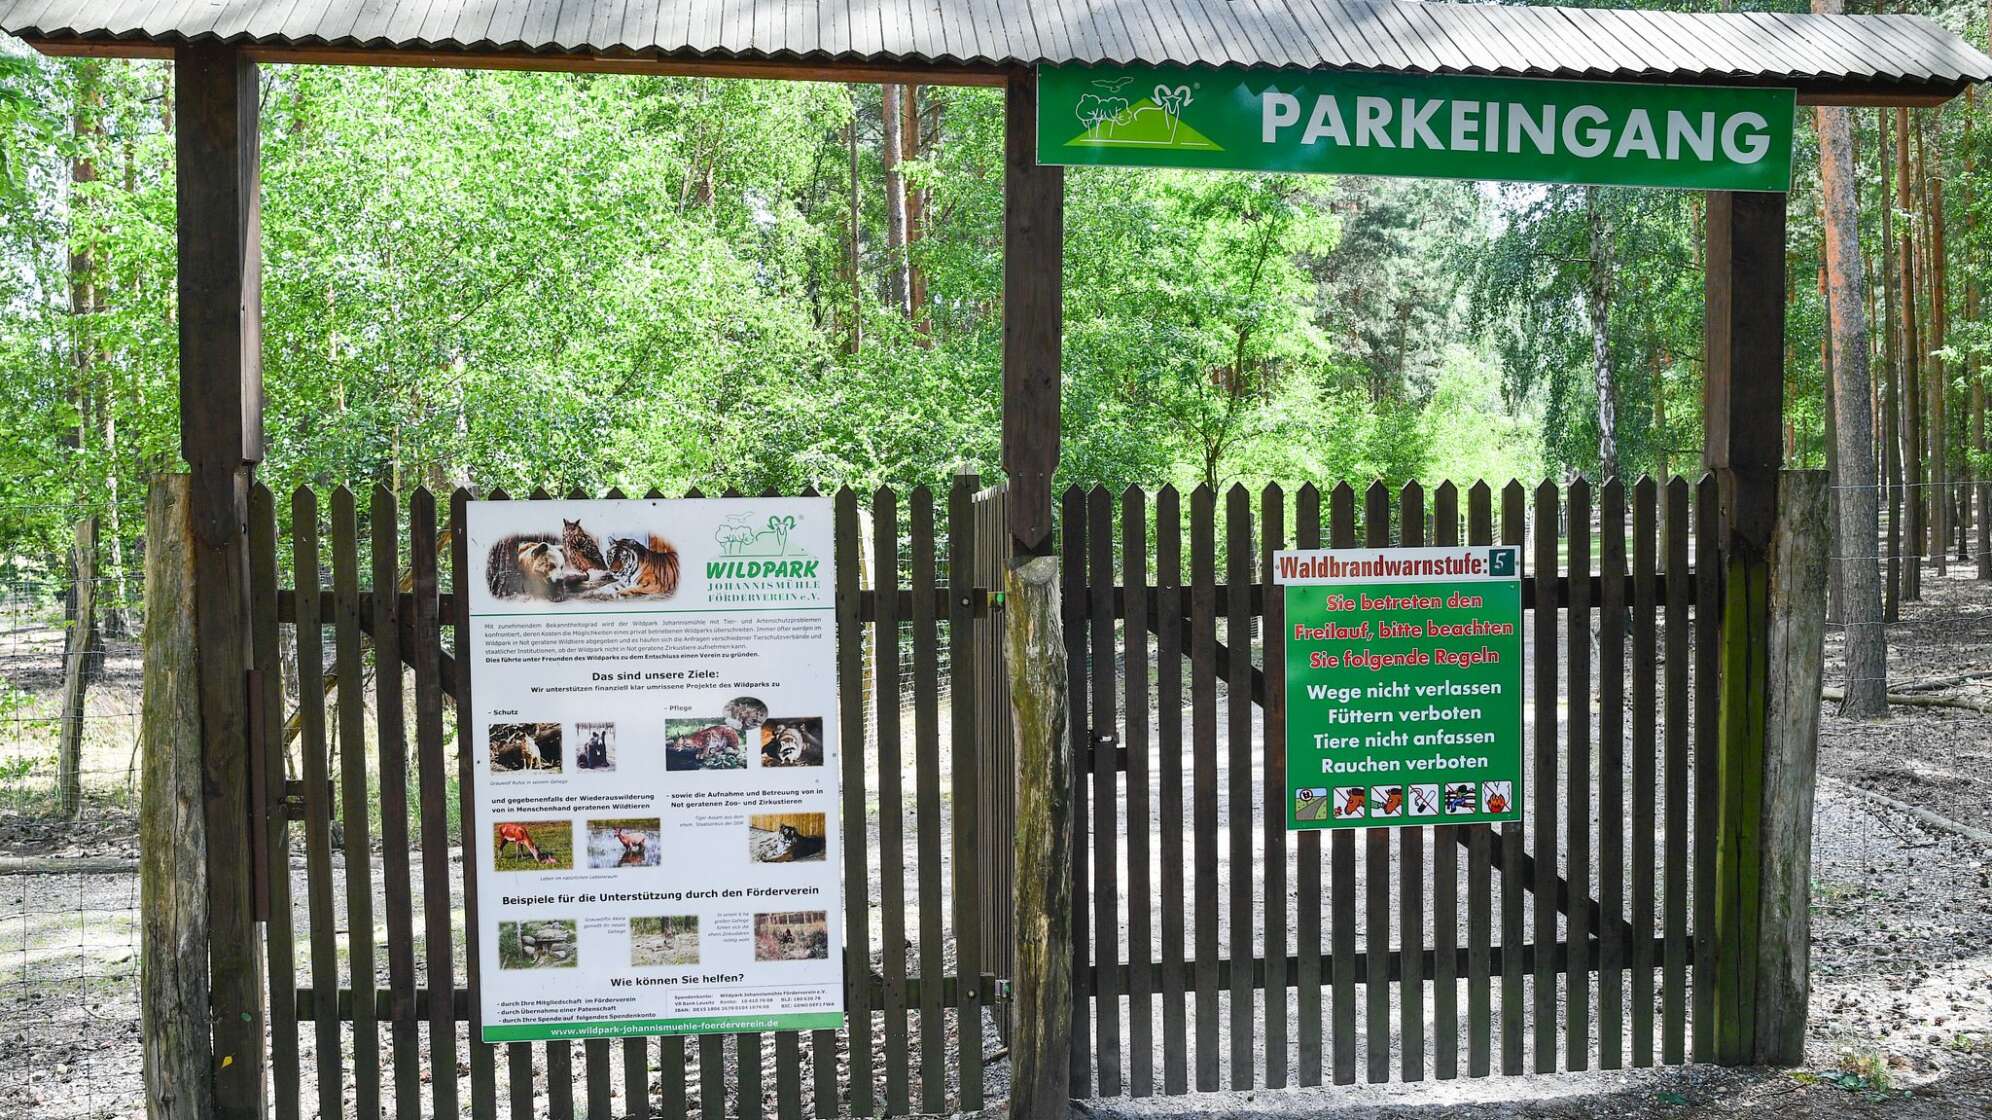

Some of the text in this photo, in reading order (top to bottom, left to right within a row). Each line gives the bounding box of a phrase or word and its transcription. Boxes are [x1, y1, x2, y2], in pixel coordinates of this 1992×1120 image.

[1262, 91, 1770, 163] PARKEINGANG
[707, 561, 819, 579] WILDPARK
[1280, 553, 1506, 578] Waldbrandwarnstufe: 5
[708, 580, 820, 591] JOHANNISMÜHLE
[708, 593, 797, 602] FÖRDERVEREIN
[1327, 591, 1482, 611] Sie betreten den
[1295, 619, 1513, 641] Freilauf, bitte beachten
[1310, 647, 1500, 670] Sie folgende Regeln
[592, 672, 613, 681] Das
[617, 671, 641, 680] sind
[688, 670, 719, 678] Ziele:
[734, 681, 769, 689] Wildparks
[1307, 680, 1501, 703] Wege nicht verlassen
[1328, 705, 1481, 724] Füttern verboten
[1314, 729, 1495, 749] Tiere nicht anfassen
[1322, 753, 1488, 774] Rauchen verboten
[503, 886, 819, 906] Beispiele für die Unterstützung durch den Förderverein
[611, 974, 744, 986] Wie können Sie helfen?
[551, 1020, 778, 1035] www.wildpark-johannismuehle-foerderverein.de
